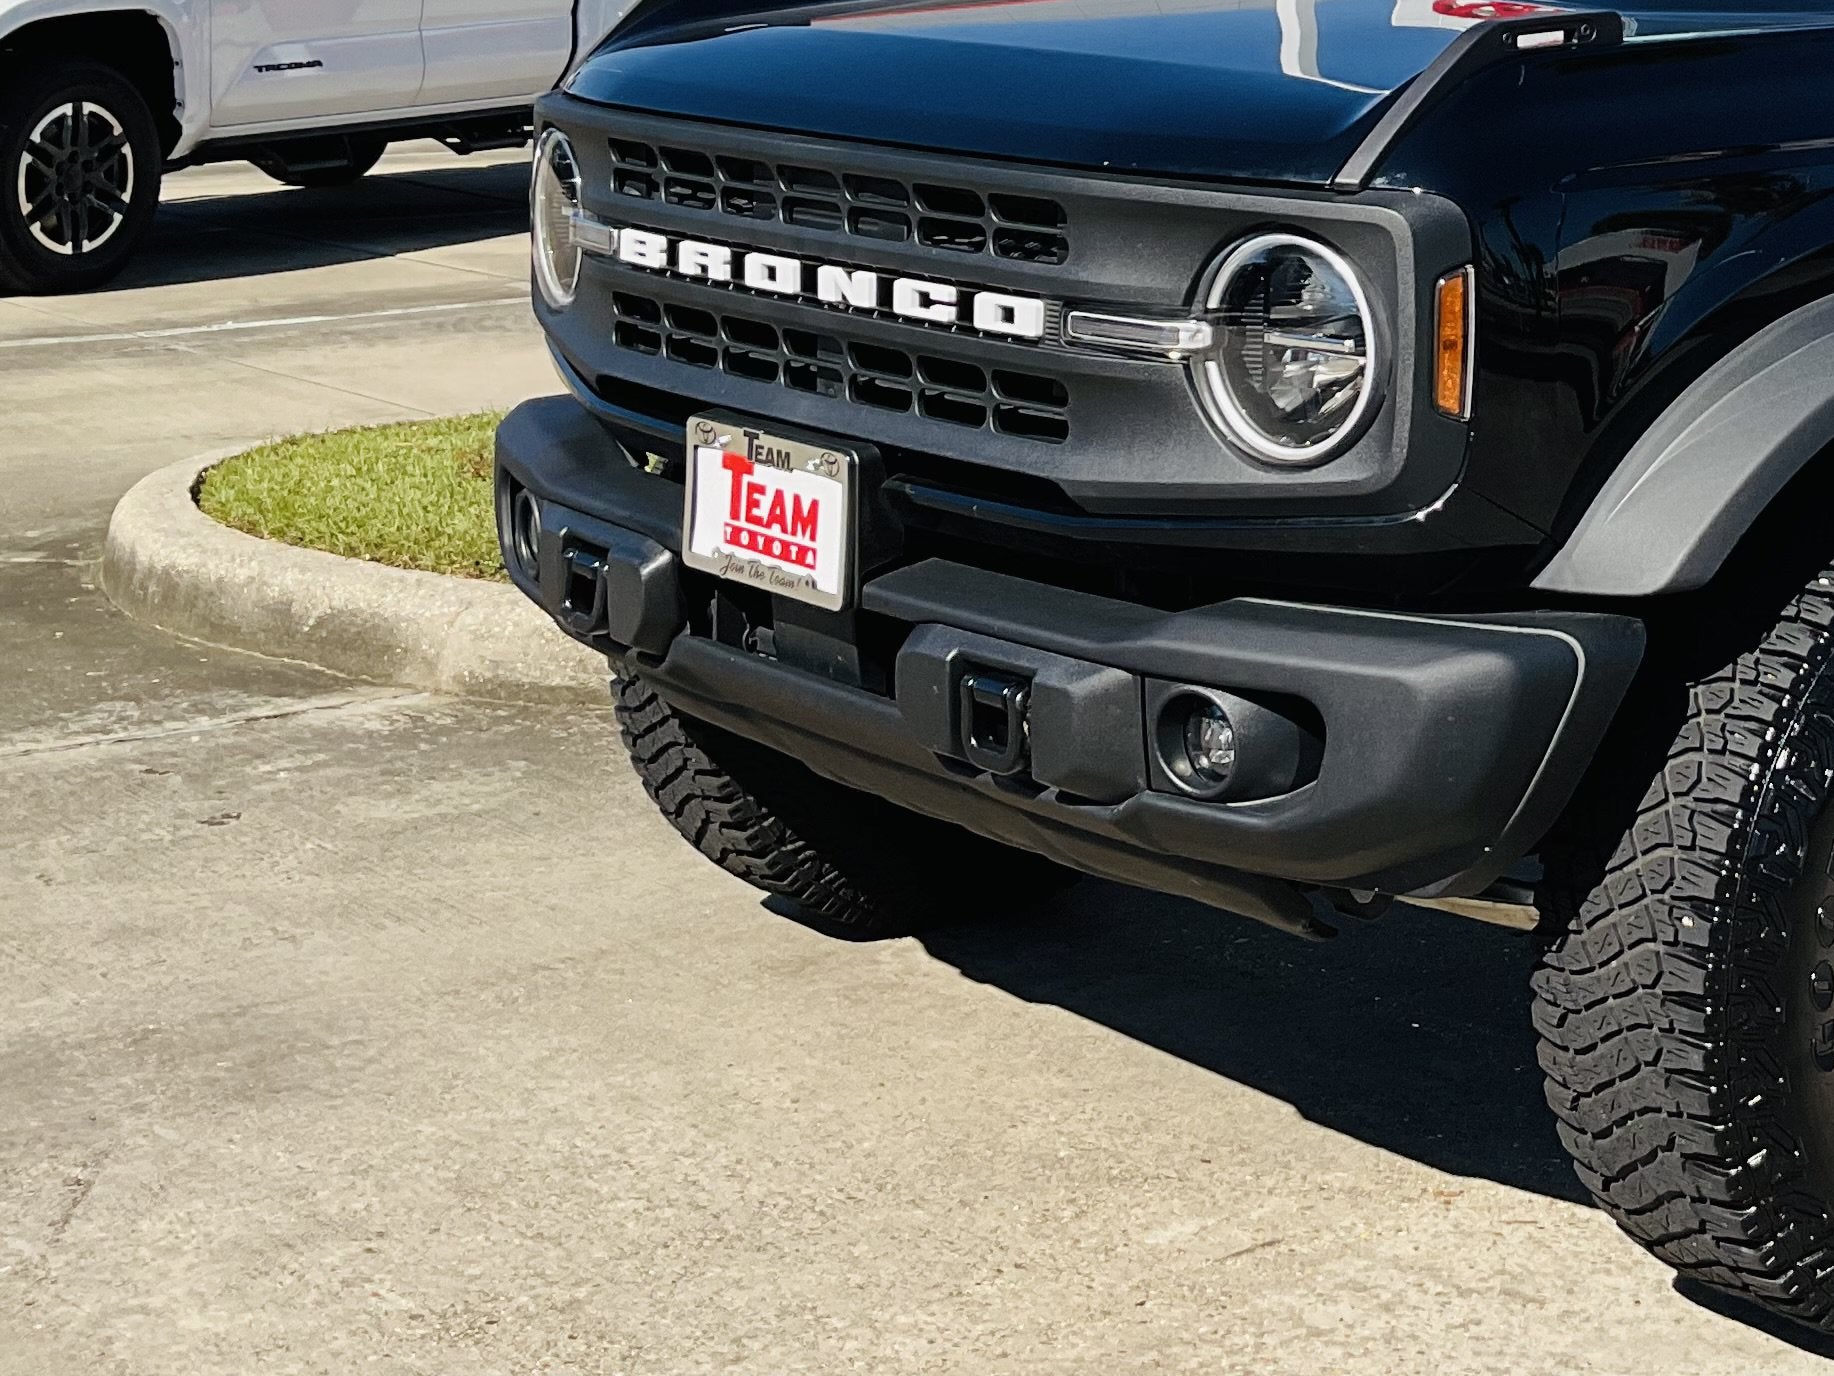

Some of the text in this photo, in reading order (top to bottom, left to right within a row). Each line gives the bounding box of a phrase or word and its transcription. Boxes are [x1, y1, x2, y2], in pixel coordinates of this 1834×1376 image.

[618, 227, 1045, 338] BRONCO
[722, 450, 819, 542] TEAM
[723, 526, 816, 566] TOYOTA
